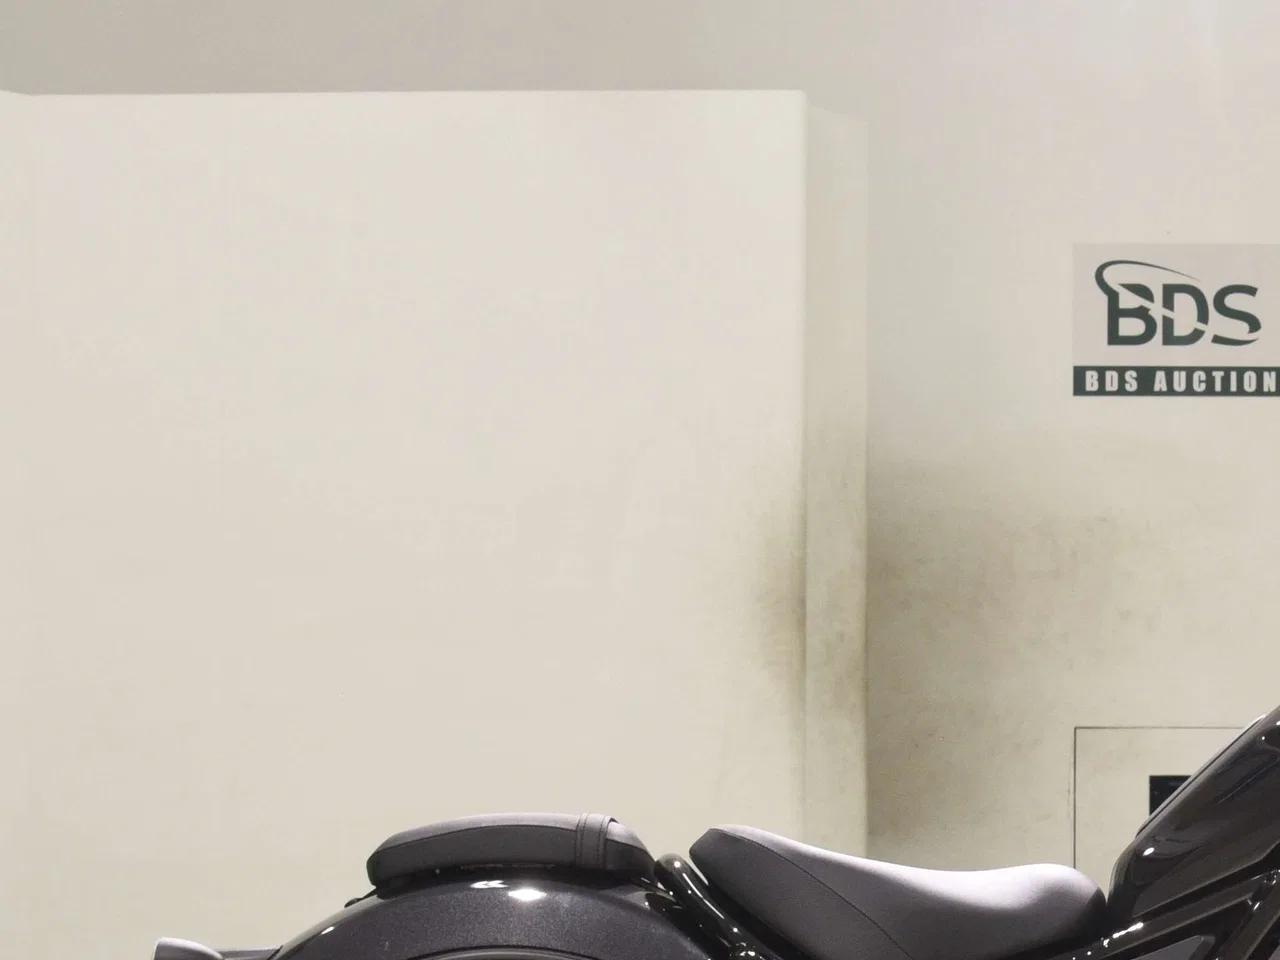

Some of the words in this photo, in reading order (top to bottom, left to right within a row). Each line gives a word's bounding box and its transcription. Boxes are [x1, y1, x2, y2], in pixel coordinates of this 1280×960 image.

[1095, 260, 1262, 347] BDS
[1085, 370, 1139, 392] BDS
[1153, 370, 1277, 393] AUCTION
